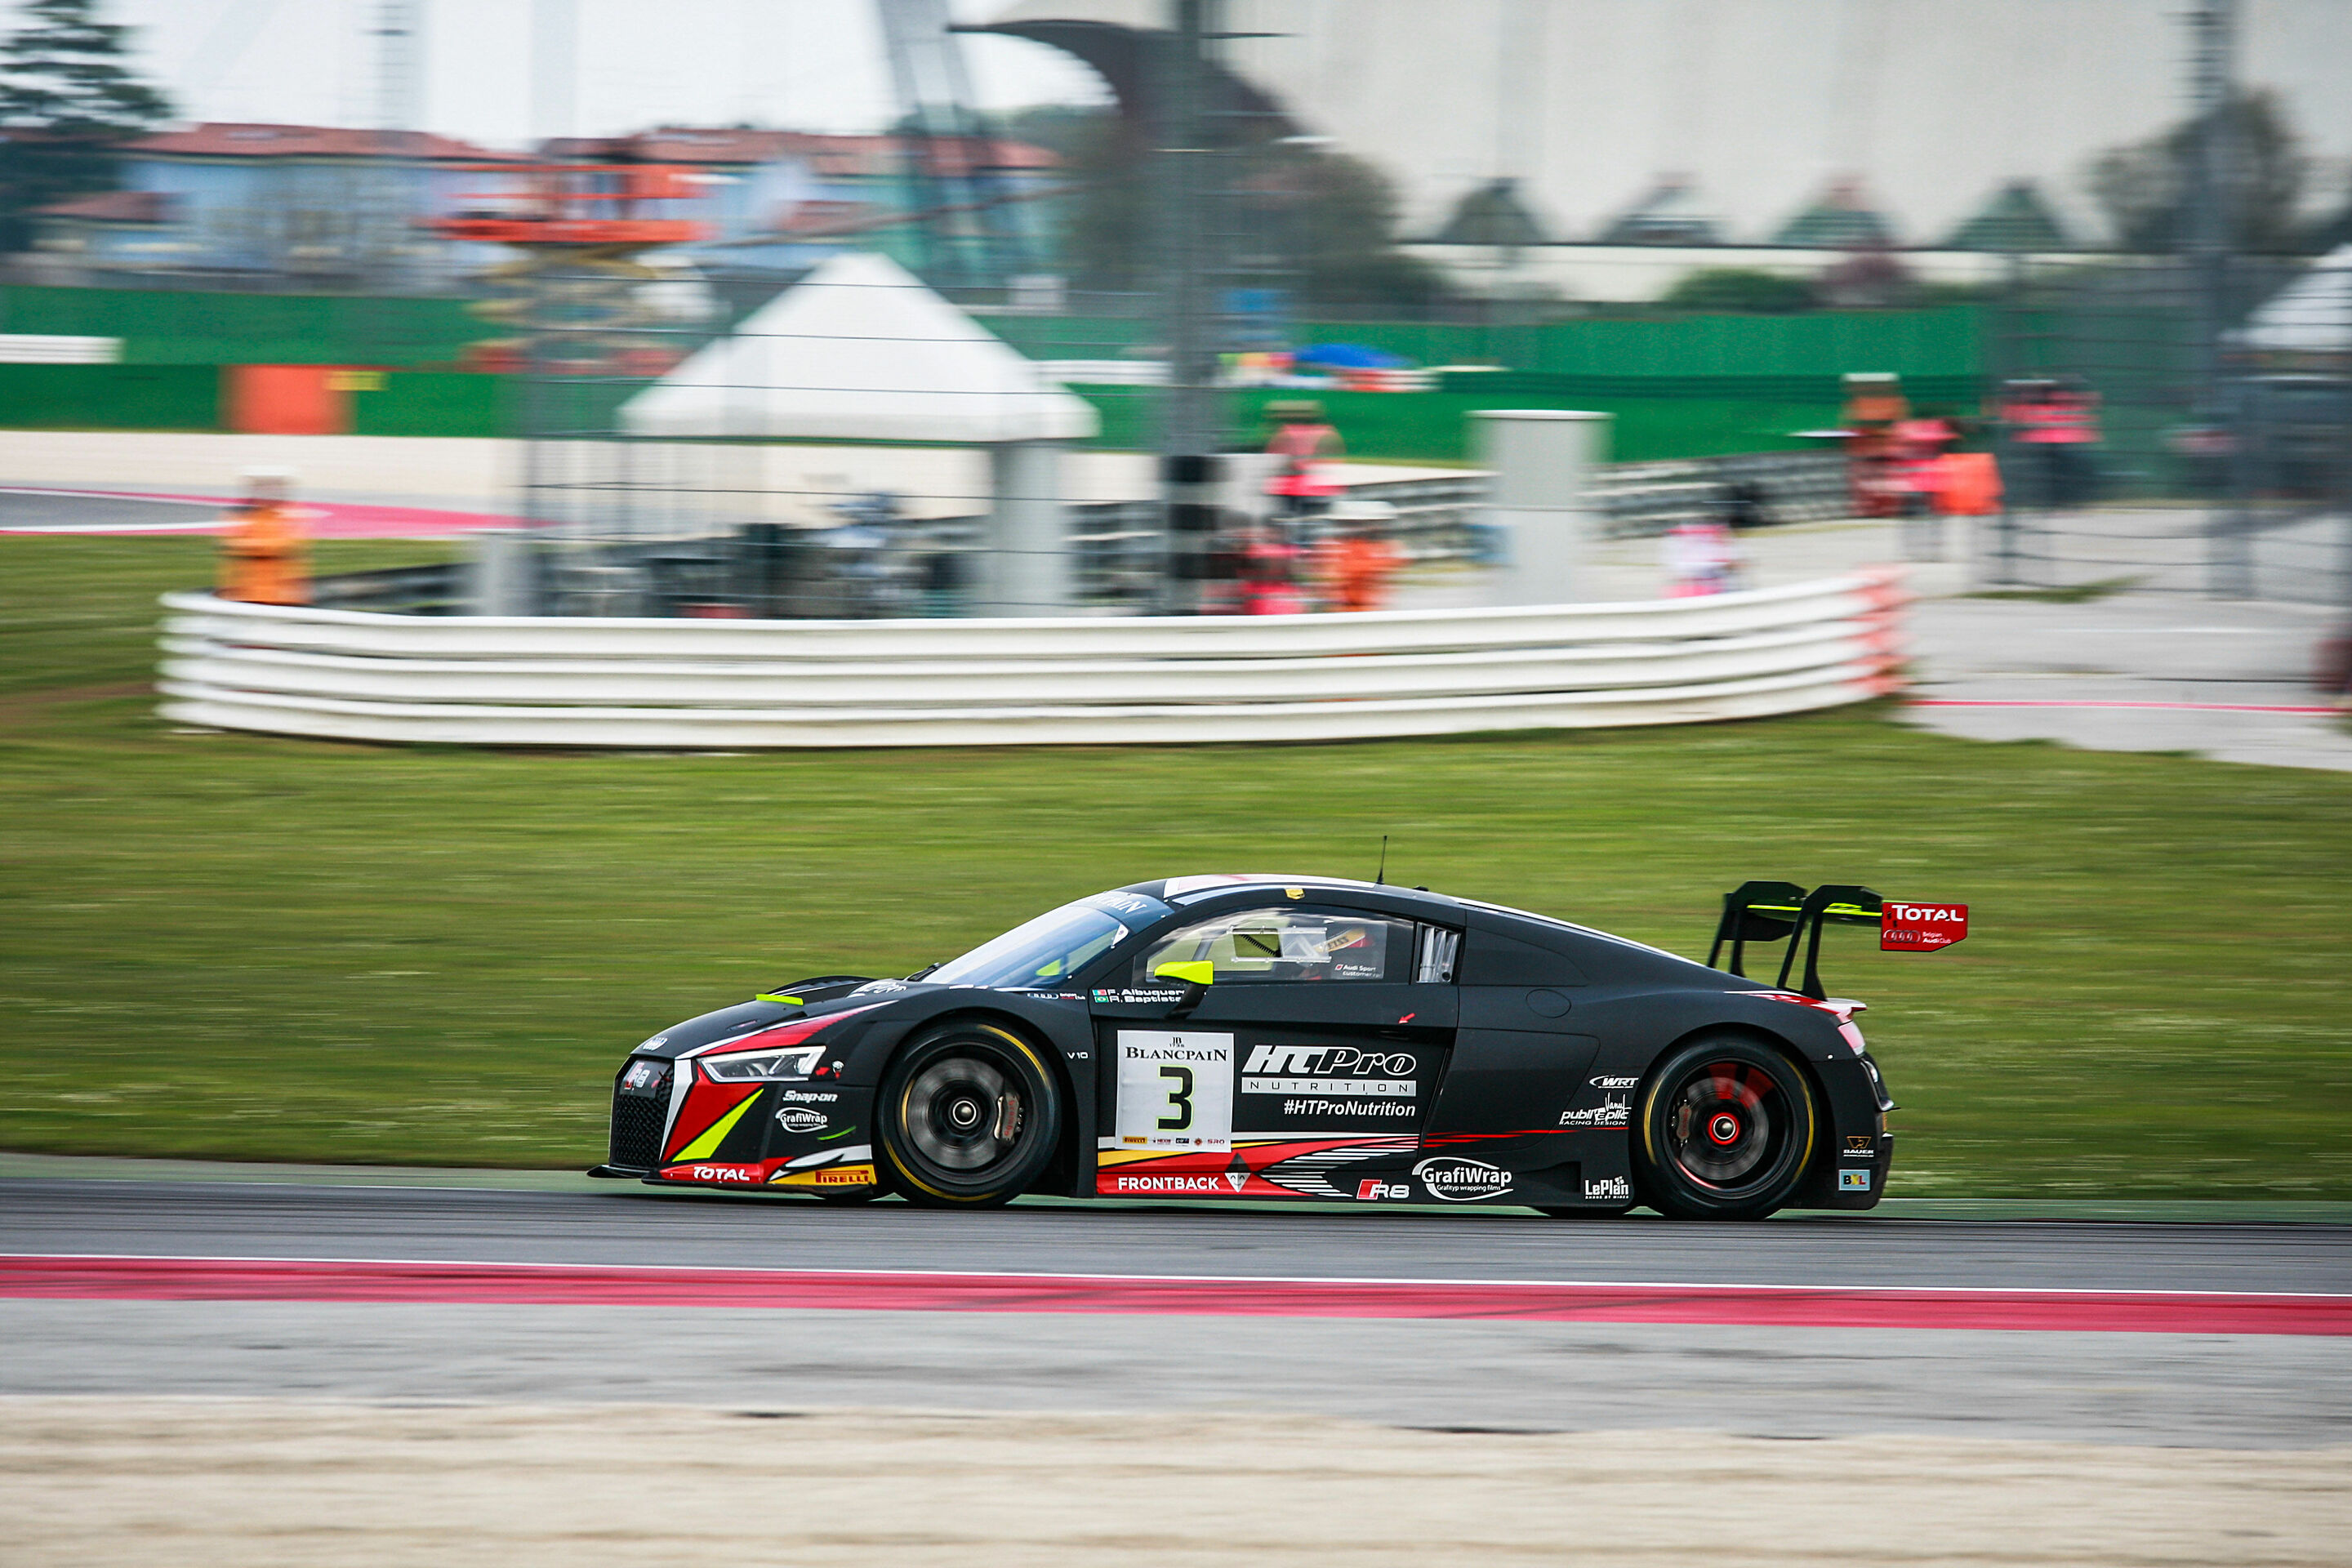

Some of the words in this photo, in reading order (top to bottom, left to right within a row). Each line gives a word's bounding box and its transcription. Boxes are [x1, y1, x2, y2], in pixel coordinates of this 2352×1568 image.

[1891, 905, 1964, 921] TOTAL
[1242, 1045, 1417, 1076] HTPro
[1250, 1081, 1409, 1093] NUTRITION
[1602, 1078, 1639, 1086] WRT
[782, 1090, 838, 1103] Snap-on
[1156, 1065, 1195, 1131] 3
[1284, 1099, 1416, 1116] #HTProNutrition
[693, 1165, 750, 1181] TOTAL
[815, 1170, 869, 1183] PIRELLI
[1422, 1167, 1512, 1187] GrafiWrap
[1843, 1174, 1866, 1185] BXL
[1117, 1177, 1219, 1190] FRONTBACK
[1585, 1179, 1629, 1195] LePlan
[1369, 1184, 1410, 1199] R8
